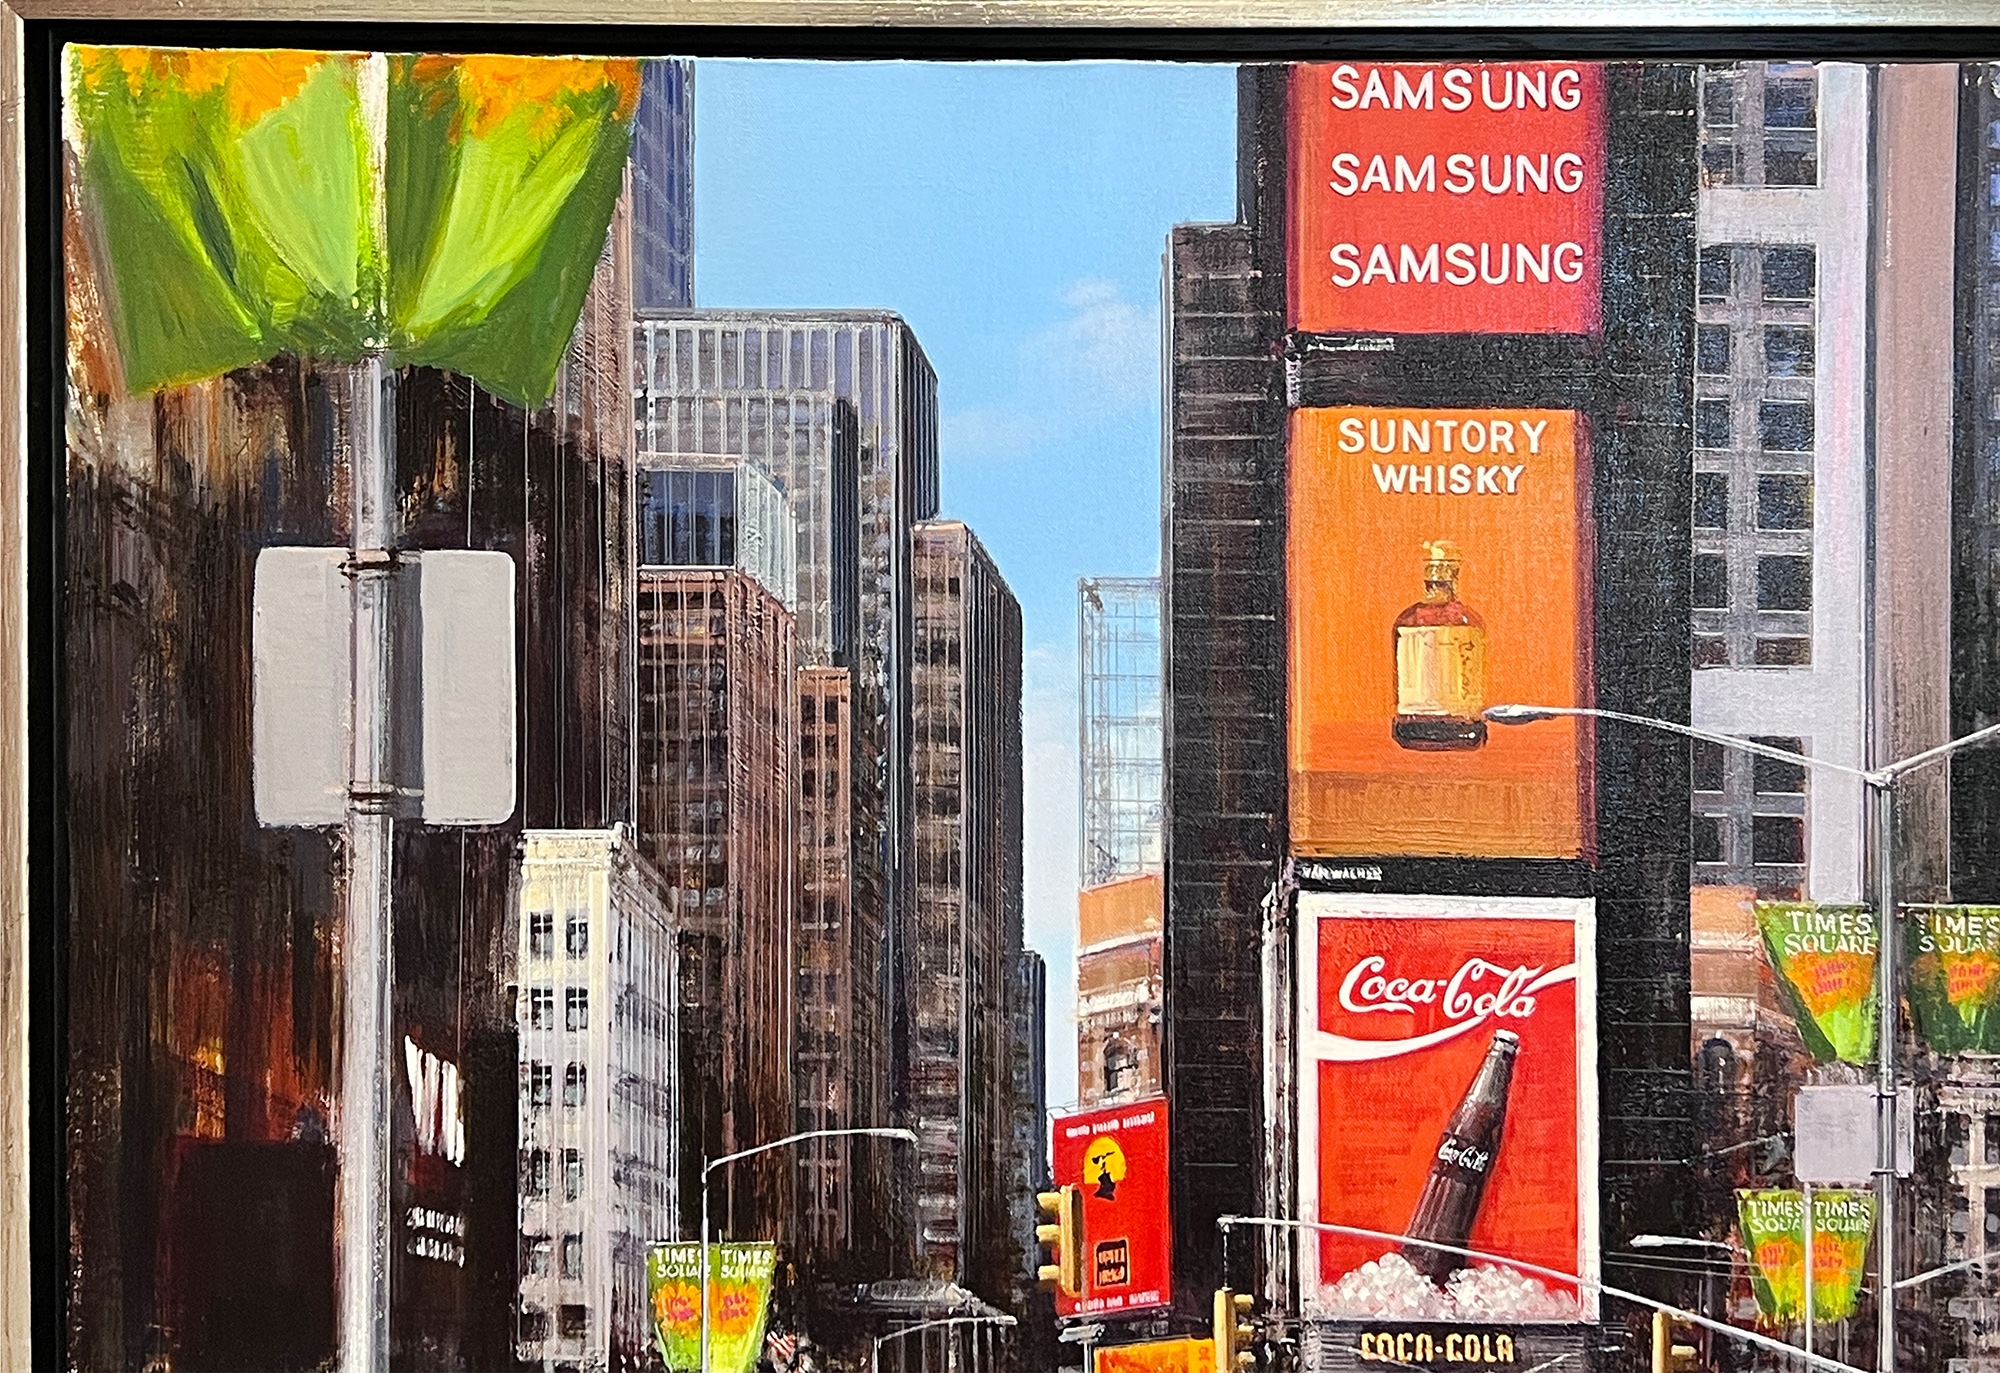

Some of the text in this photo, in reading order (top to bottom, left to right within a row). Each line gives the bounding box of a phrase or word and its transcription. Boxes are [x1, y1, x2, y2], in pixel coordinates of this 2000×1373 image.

[1330, 65, 1582, 111] SAMSUNG
[1329, 152, 1584, 196] SAMSUNG
[1329, 241, 1584, 287] SAMSUNG
[1338, 418, 1547, 455] SUNTORY
[1372, 463, 1526, 495] WHISKY
[1785, 911, 1873, 935] TIMES
[1784, 933, 1878, 955] SQUARE
[1338, 955, 1545, 1019] Coca-Cola
[1814, 1201, 1871, 1218] TIMES
[720, 1249, 773, 1265] TIMES
